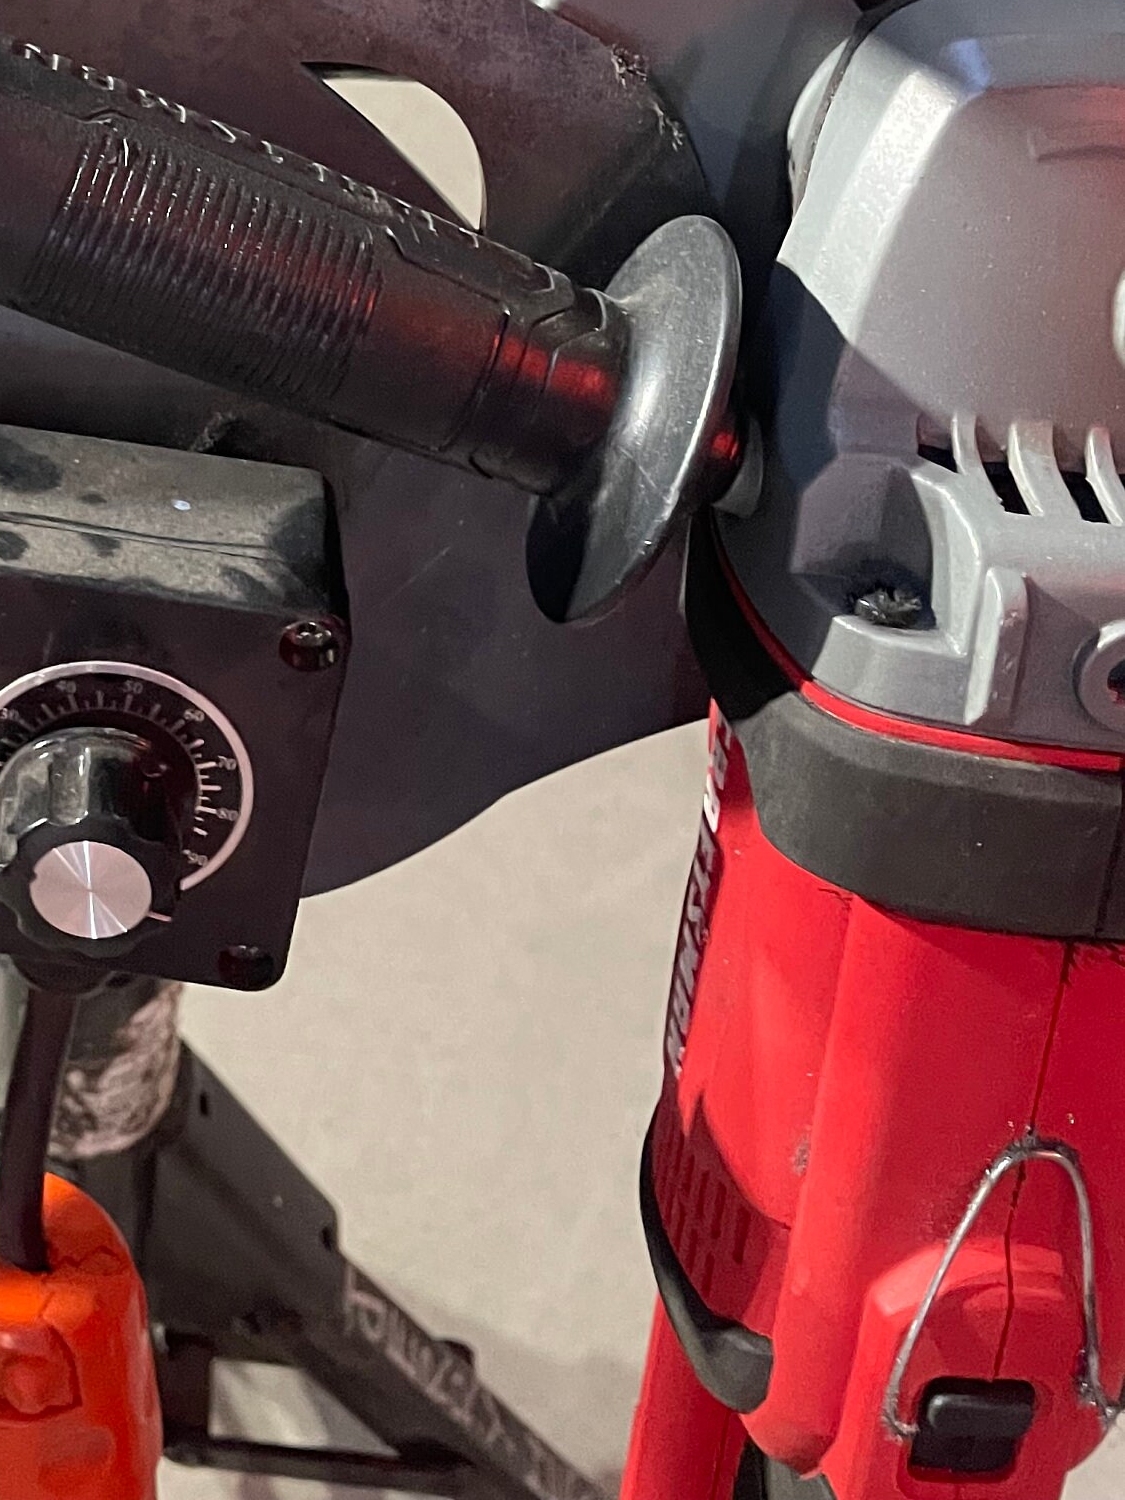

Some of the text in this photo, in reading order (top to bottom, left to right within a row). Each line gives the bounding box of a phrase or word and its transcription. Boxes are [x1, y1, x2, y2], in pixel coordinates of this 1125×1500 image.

[57, 680, 77, 694] 40
[123, 680, 144, 694] 50
[0, 706, 21, 721] 30
[183, 708, 206, 723] 60
[217, 756, 238, 771] 70
[217, 808, 240, 821] 80
[187, 852, 210, 867] 90
